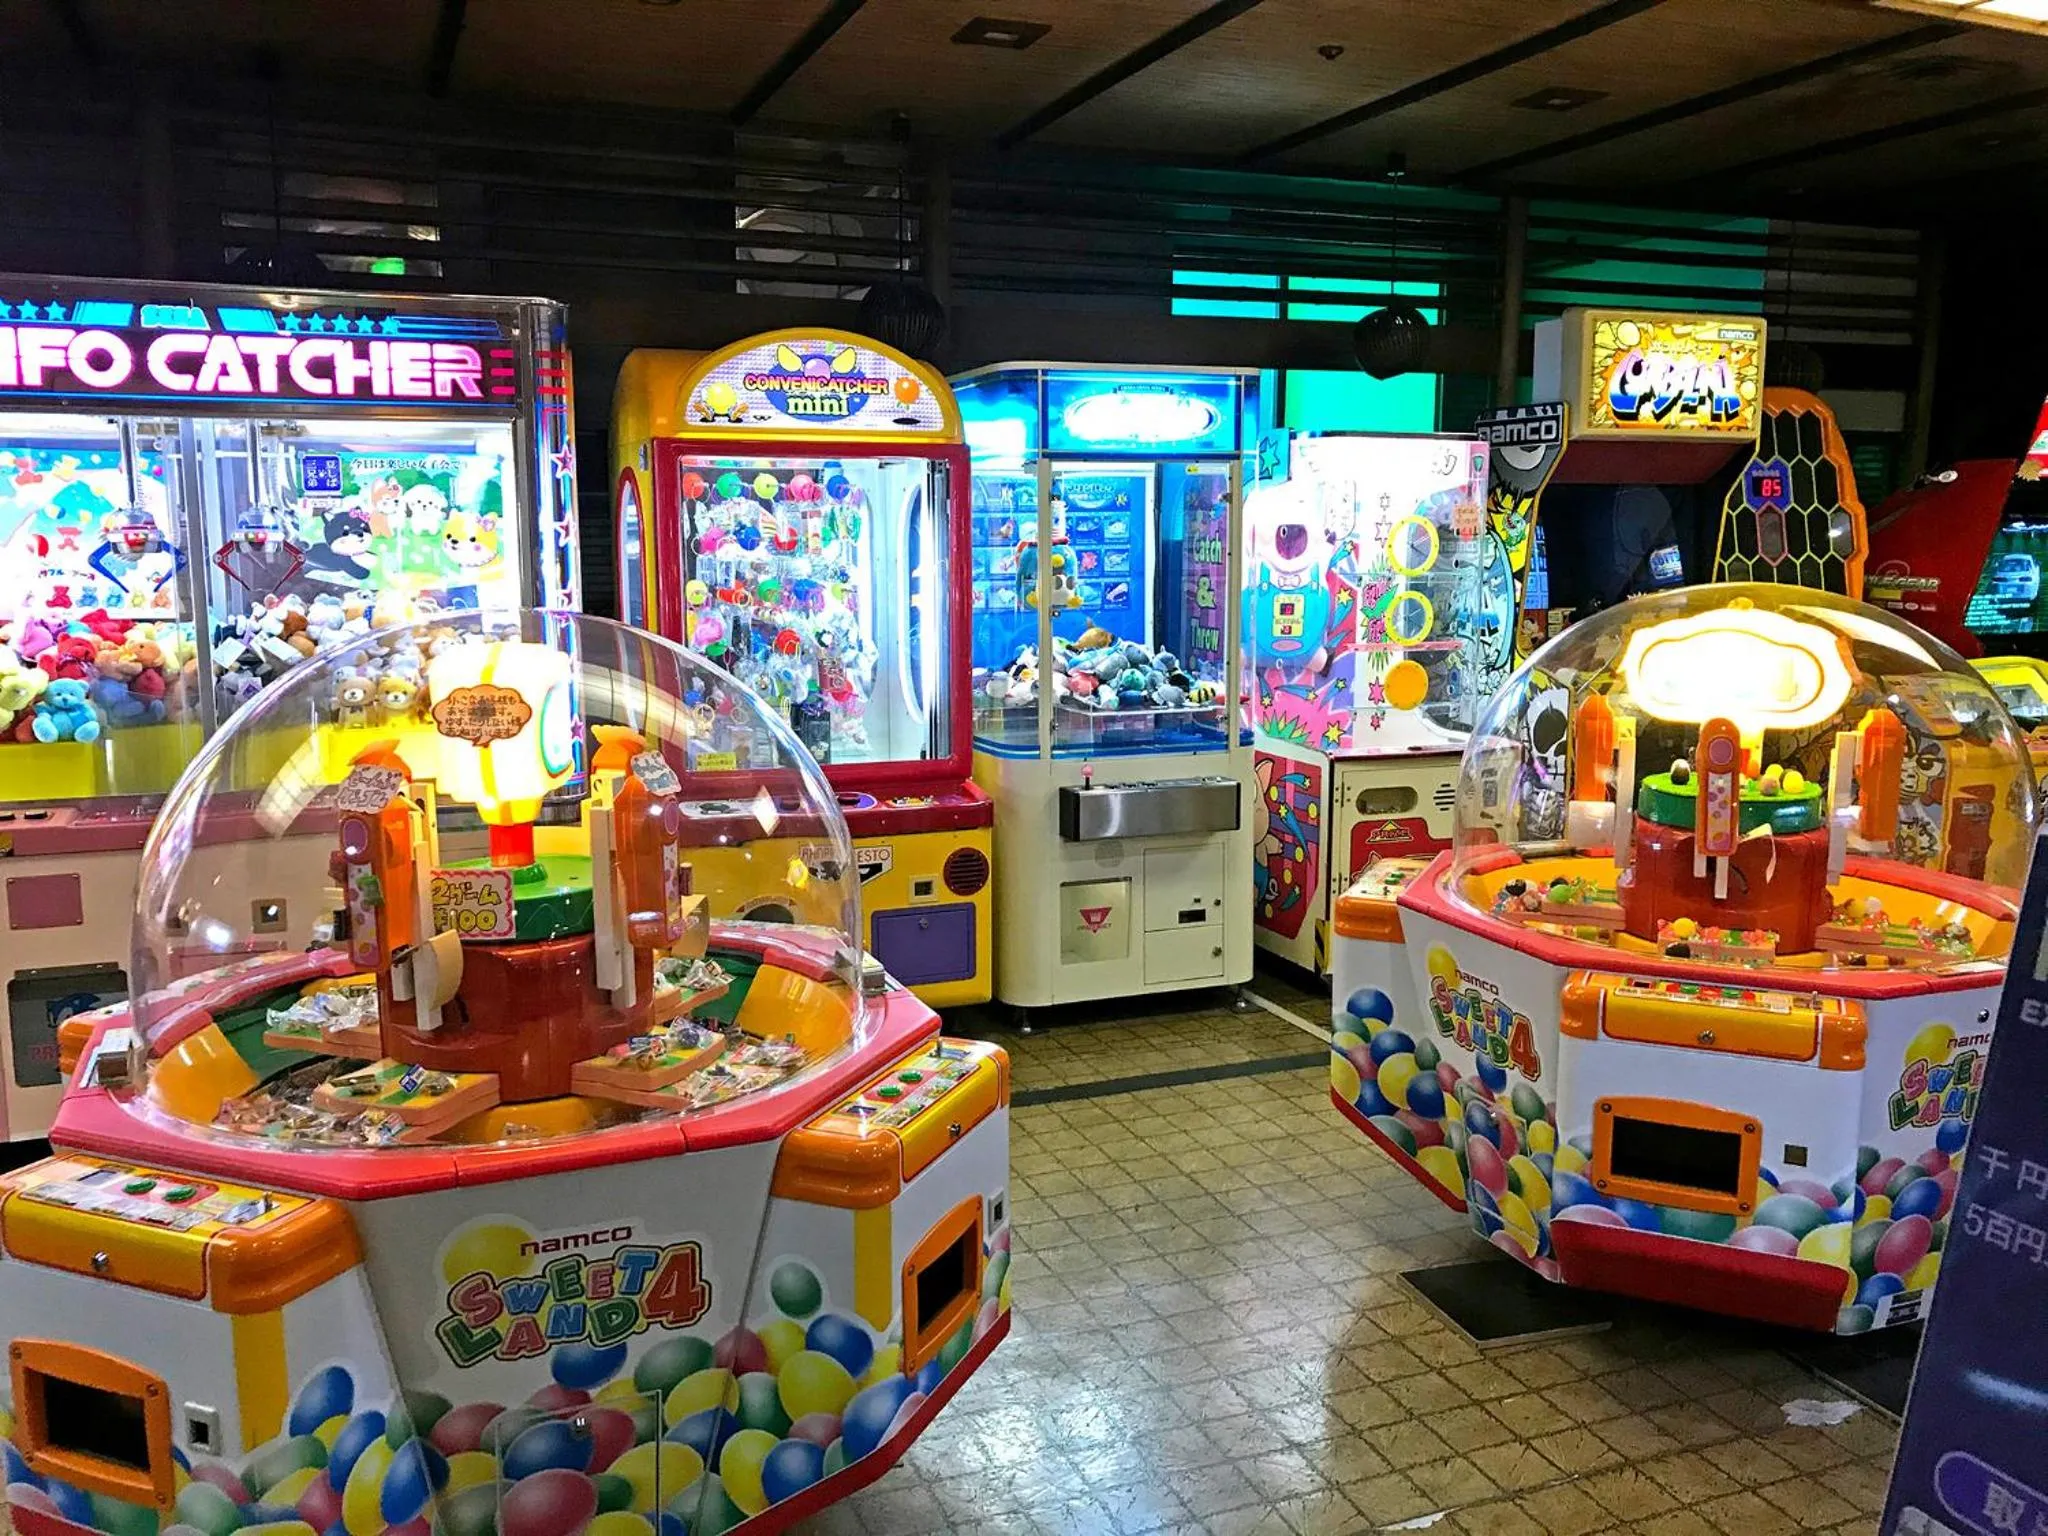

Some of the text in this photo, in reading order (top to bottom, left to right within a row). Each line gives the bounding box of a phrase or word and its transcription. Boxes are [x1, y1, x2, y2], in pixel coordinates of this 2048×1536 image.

[147, 333, 485, 398] CATCHER
[744, 373, 890, 395] CONVENICATCHER
[787, 393, 850, 416] mini
[1478, 420, 1559, 445] namco
[1762, 479, 1782, 497] 85
[431, 877, 502, 905] 2ゲーム
[1431, 976, 1515, 1039] SWEET
[1455, 969, 1499, 996] namco
[1430, 997, 1511, 1069] LAND
[1509, 1012, 1542, 1082] 4
[1900, 1050, 1986, 1102] SWEE
[520, 1226, 633, 1258] namco
[1964, 1203, 2048, 1268] 5百円
[448, 1246, 660, 1328] SWEET
[641, 1240, 712, 1328] 4
[436, 1296, 642, 1368] LAND
